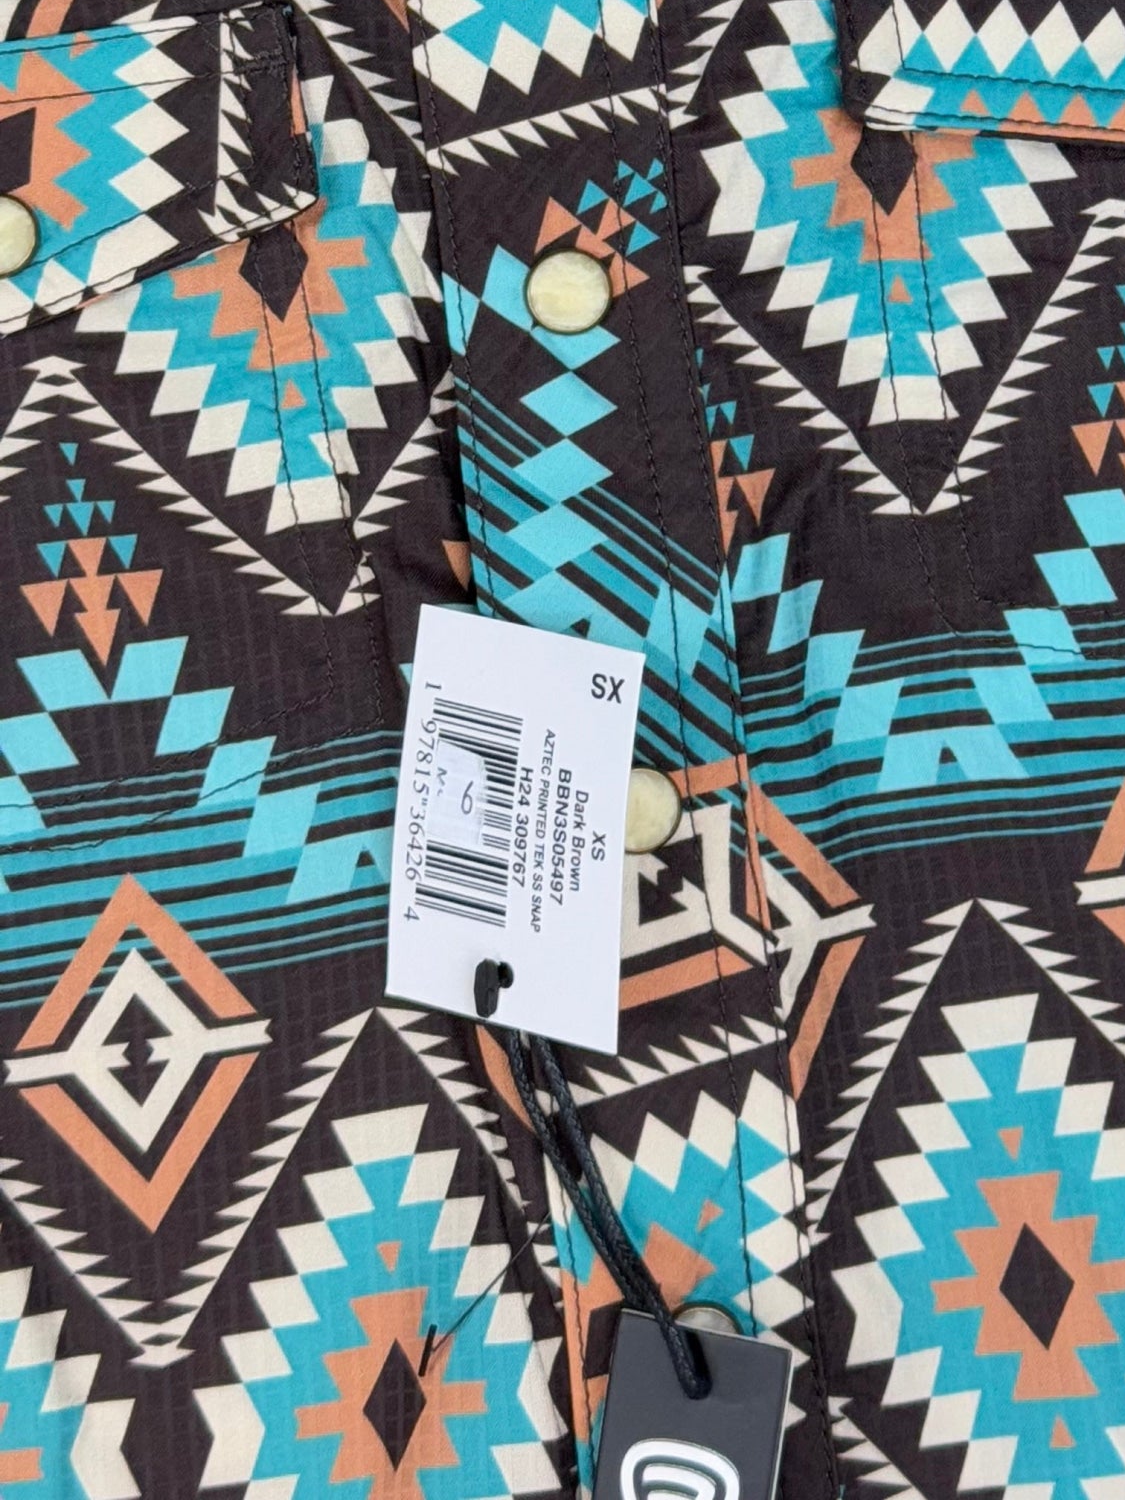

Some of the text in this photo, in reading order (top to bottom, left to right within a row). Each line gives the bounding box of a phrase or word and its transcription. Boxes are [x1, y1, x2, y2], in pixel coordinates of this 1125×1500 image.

[424, 681, 442, 690] 1
[591, 673, 625, 704] XS
[512, 766, 534, 888] H24 309767
[529, 728, 556, 933] AZTEC PRINTED TEK SS SNAP
[549, 767, 573, 906] BBN3S05497
[569, 790, 589, 891] Dark Brown
[591, 830, 607, 862] XS
[403, 906, 421, 921] 4
